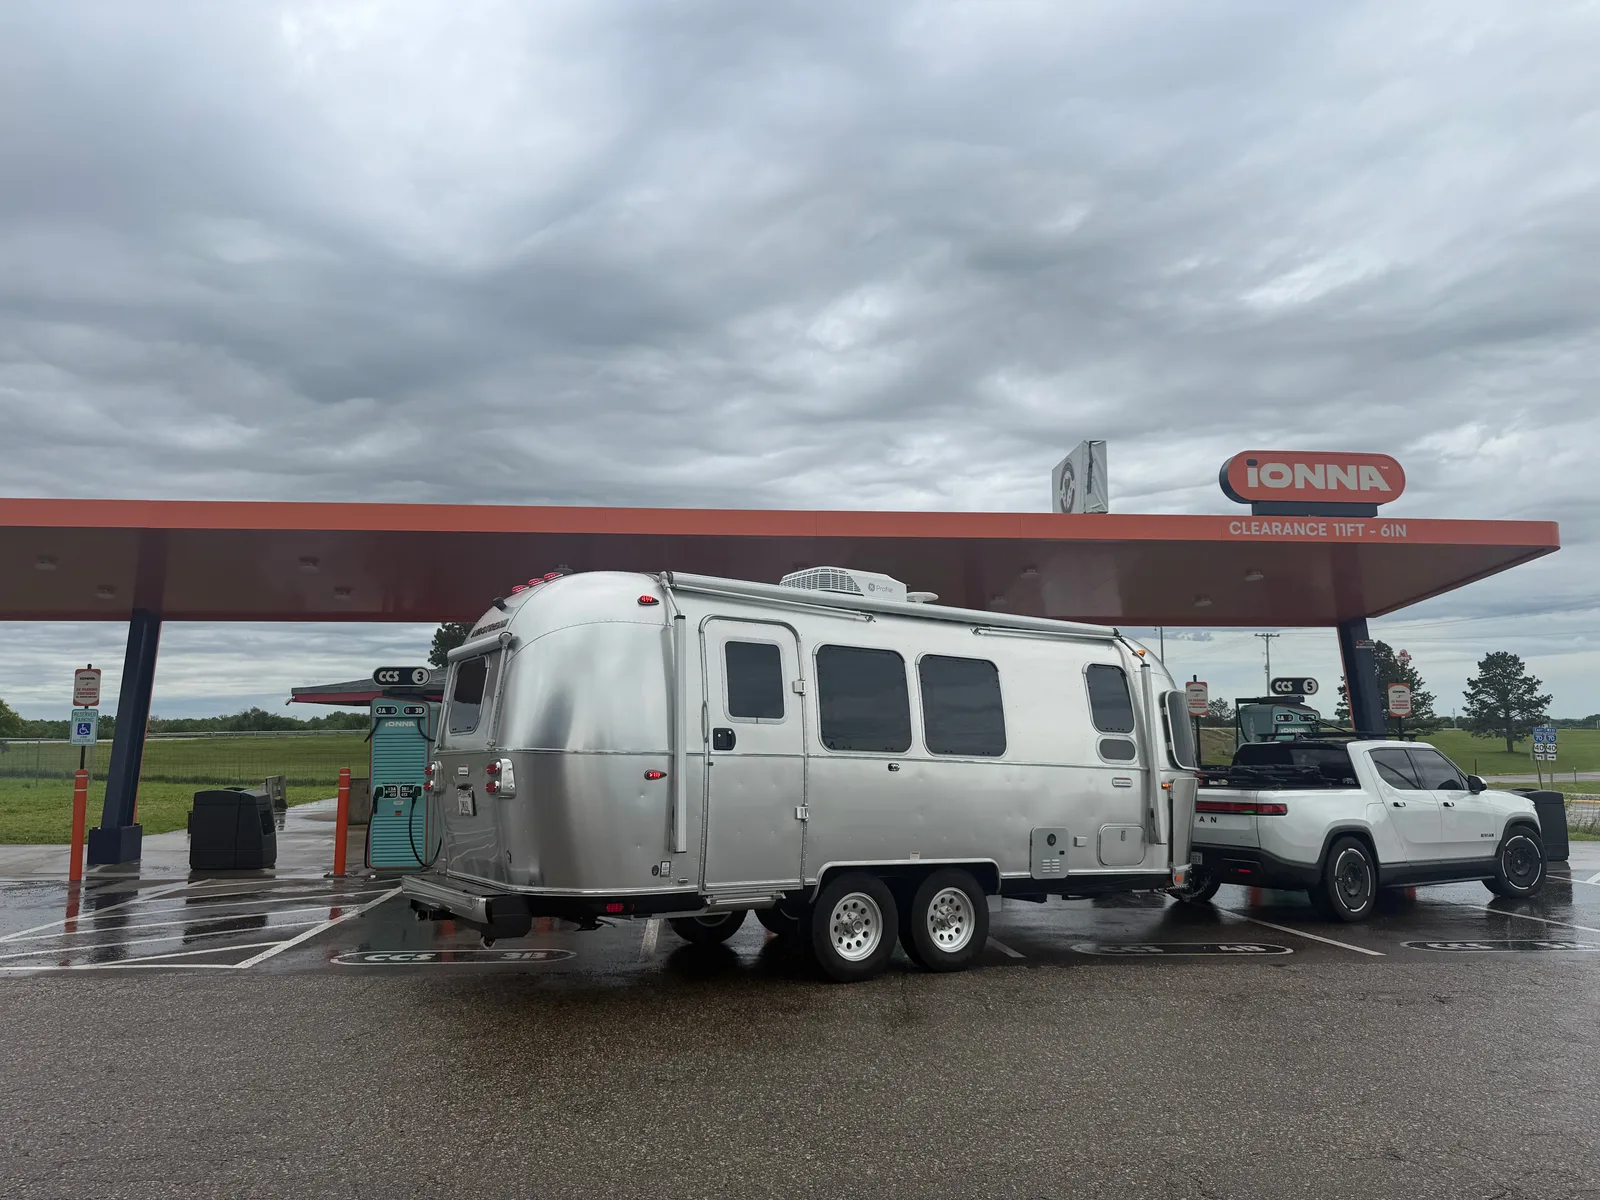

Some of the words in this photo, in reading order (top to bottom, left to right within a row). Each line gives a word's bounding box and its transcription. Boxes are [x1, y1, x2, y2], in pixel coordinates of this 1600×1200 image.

[1229, 521, 1328, 536] CLEARANCE
[1333, 523, 1365, 537] 11FT
[1380, 525, 1407, 537] 6IN
[379, 671, 400, 682] CCS
[417, 671, 424, 682] 3
[1275, 681, 1293, 691] CCS
[1306, 681, 1313, 691] 5
[364, 953, 437, 961] CCS
